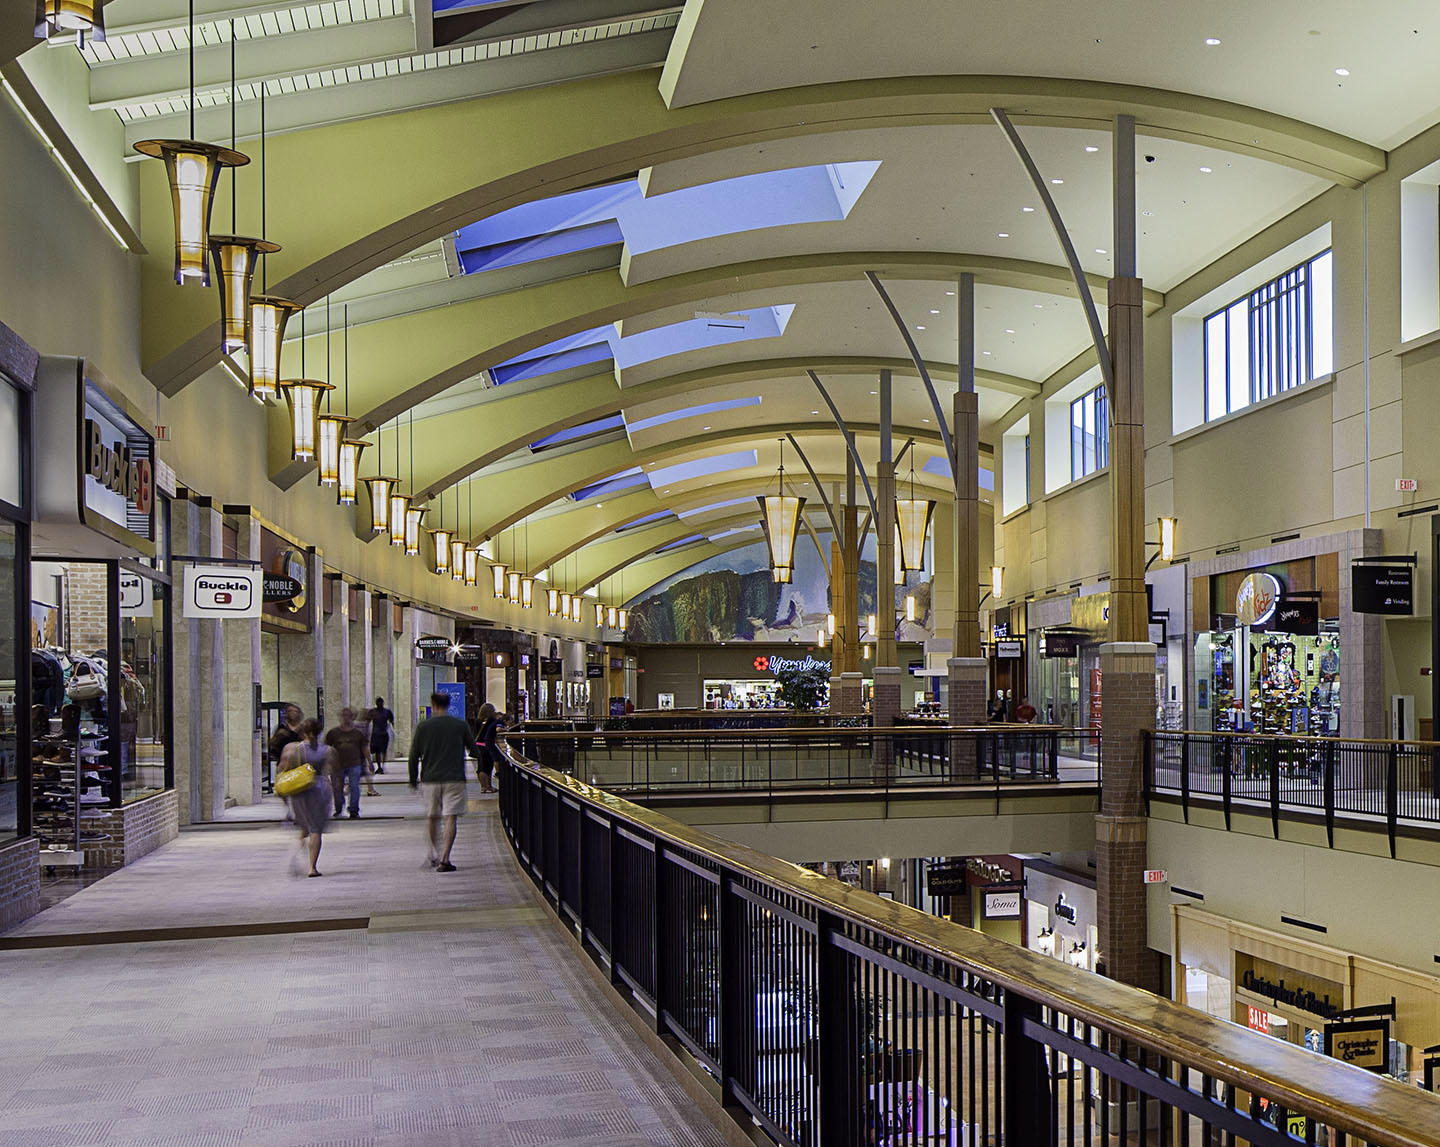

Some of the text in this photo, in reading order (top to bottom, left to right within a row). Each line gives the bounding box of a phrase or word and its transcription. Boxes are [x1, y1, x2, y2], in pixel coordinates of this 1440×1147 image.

[1400, 480, 1413, 490] EXIT
[199, 581, 248, 591] Buckle
[269, 581, 293, 590] NOBLE
[1149, 871, 1163, 882] EXIT
[986, 898, 1017, 909] Soma
[1250, 1007, 1267, 1030] SALE
